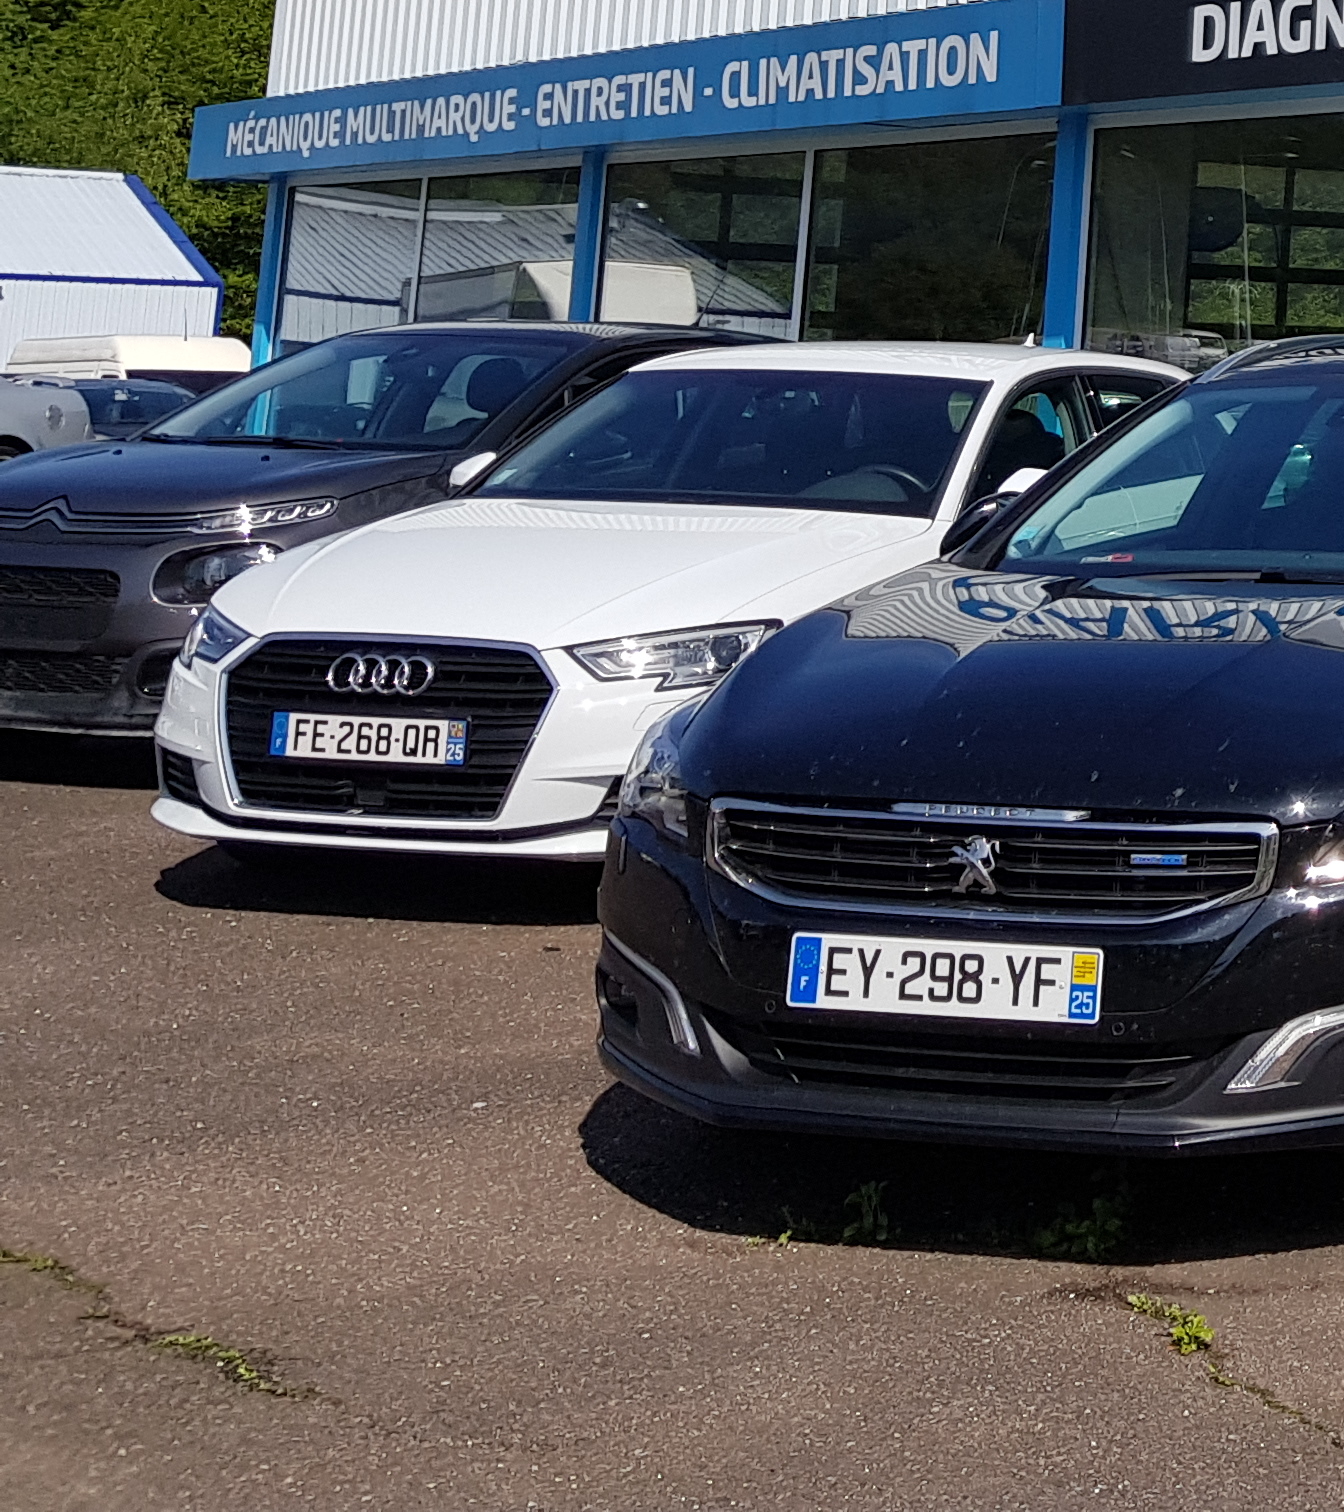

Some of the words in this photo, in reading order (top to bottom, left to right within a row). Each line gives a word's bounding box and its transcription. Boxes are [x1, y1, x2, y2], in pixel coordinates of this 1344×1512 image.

[225, 108, 342, 158] MÉCANIQUE
[345, 87, 519, 143] MULTIMARQUE
[535, 66, 695, 127] ENTRETIEN
[721, 30, 999, 110] CLIMATISATION
[275, 738, 283, 749] F
[293, 719, 441, 758] FE-268-QR
[446, 743, 464, 761] 25
[799, 975, 809, 992] F
[824, 946, 1063, 1008] EY-298-YF
[1070, 991, 1094, 1014] 25
